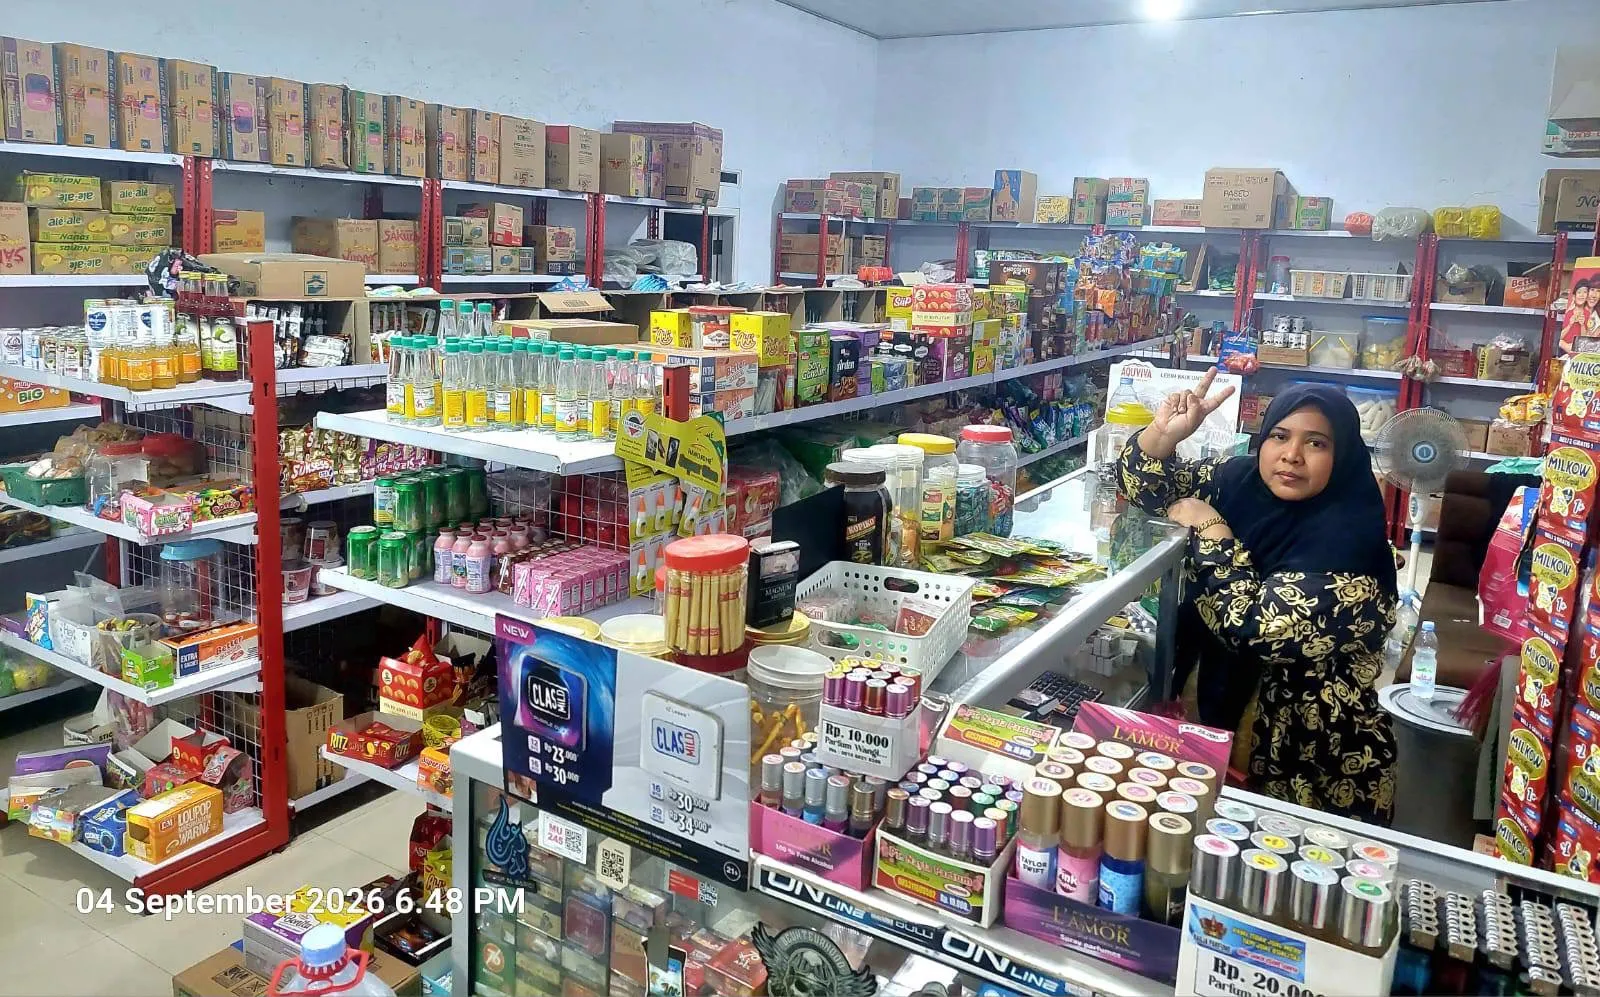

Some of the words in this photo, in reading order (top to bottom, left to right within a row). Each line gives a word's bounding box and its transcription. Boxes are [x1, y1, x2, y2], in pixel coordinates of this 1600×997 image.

[58, 191, 94, 202] ale-ale
[119, 187, 148, 198] ale-ale
[1223, 189, 1250, 198] PASEO
[48, 215, 83, 226] ale-ale
[69, 258, 102, 270] ale-ale
[1568, 361, 1600, 376] MILKO
[18, 388, 44, 404] BIG
[1547, 455, 1591, 479] MILKOW
[846, 516, 876, 536] KOPIKO
[1533, 549, 1572, 578] MILKOW
[765, 583, 792, 595] MAGNUM
[502, 623, 530, 639] NEW
[216, 636, 244, 655] Better
[181, 652, 198, 663] EXTRA
[1525, 644, 1556, 674] MILKOW
[532, 683, 557, 710] CLAS
[556, 689, 567, 713] MILD
[330, 732, 349, 751] RITZ
[656, 726, 685, 755] CLAS
[684, 732, 696, 757] MILD
[825, 736, 852, 750] Parfum
[826, 723, 844, 738] Rp.
[848, 729, 889, 749] 10.000
[1510, 733, 1542, 769] MILKOW
[177, 800, 212, 827] LOLIPOP
[179, 820, 211, 846] WARNA
[549, 824, 563, 835] MU
[547, 832, 564, 846] 245
[1021, 855, 1047, 869] TAYLOR
[1022, 864, 1045, 874] SWIFT
[768, 871, 824, 906] ON
[1060, 933, 1083, 948] Spray
[941, 930, 1011, 973] ON
[1213, 956, 1245, 983] Rp.
[1253, 971, 1328, 997] 20.00
